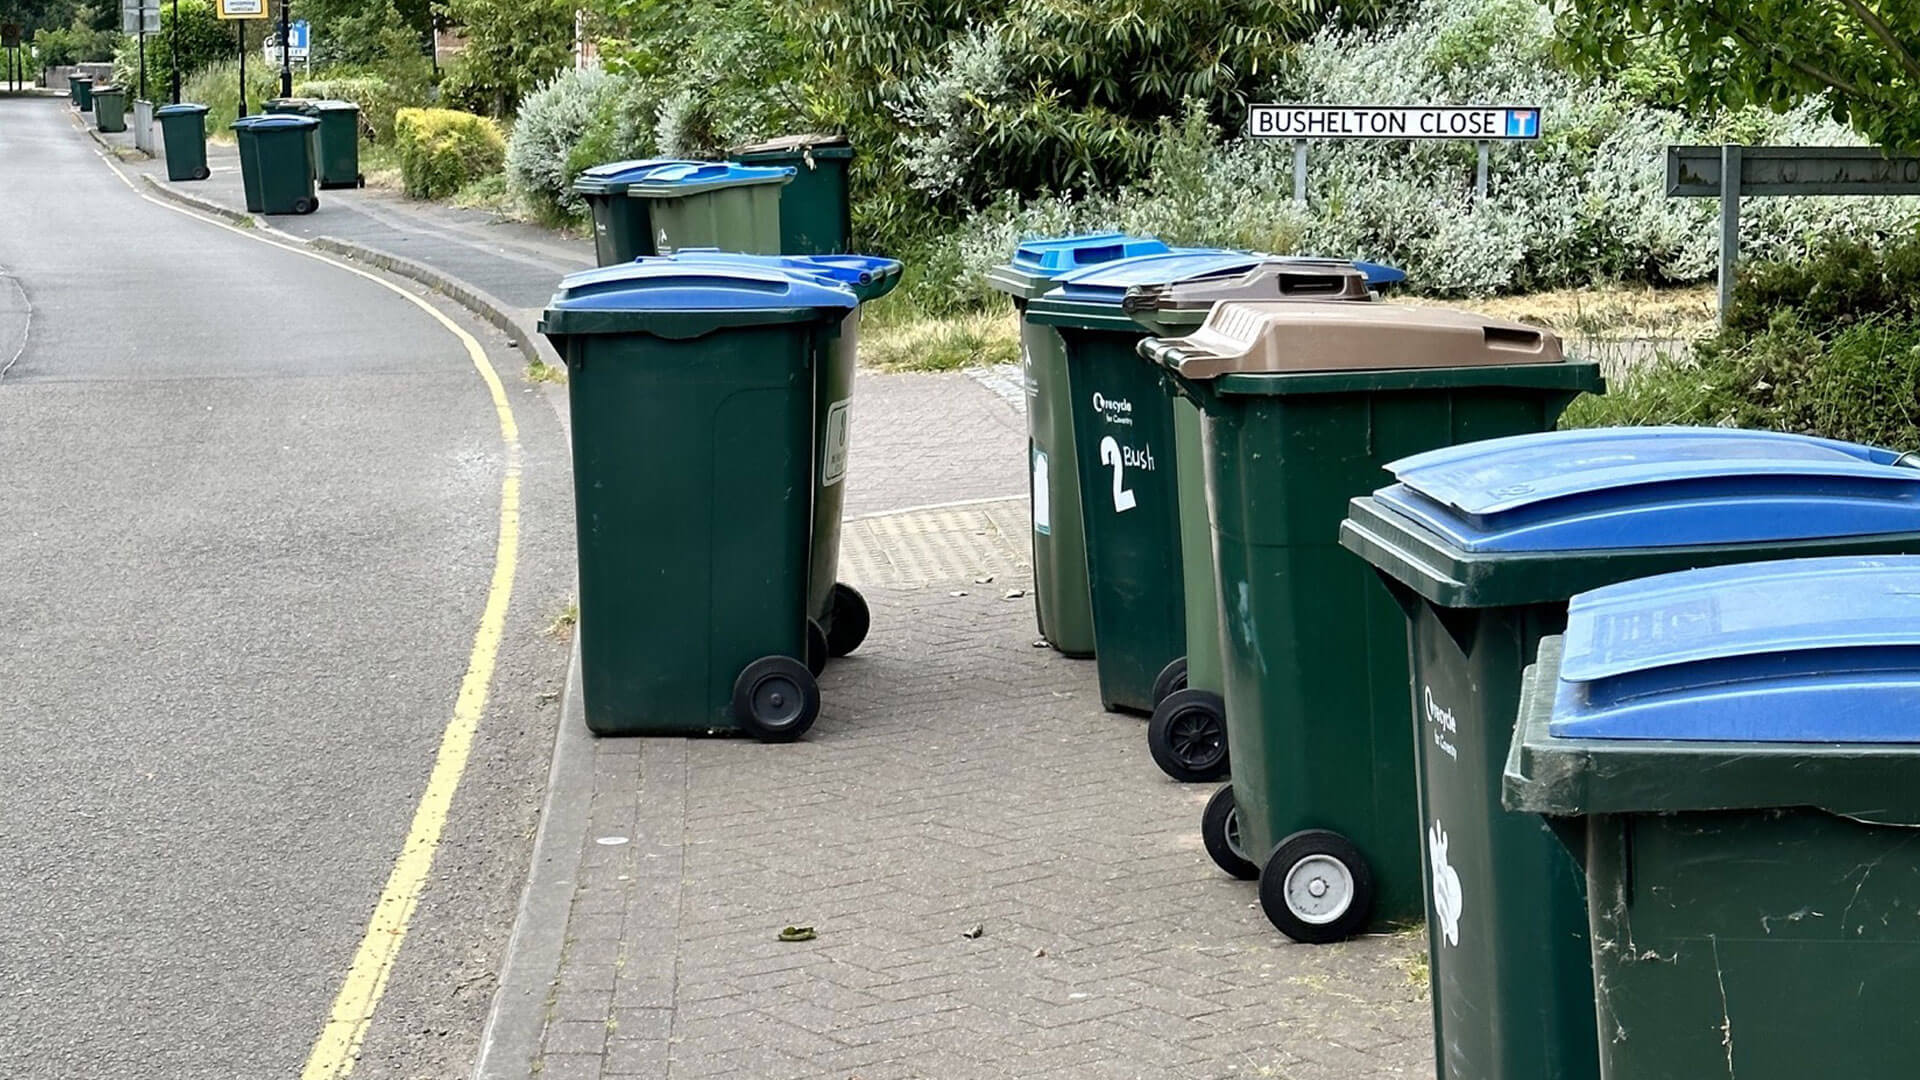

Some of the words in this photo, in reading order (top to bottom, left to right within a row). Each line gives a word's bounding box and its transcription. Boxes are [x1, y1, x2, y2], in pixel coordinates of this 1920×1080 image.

[1259, 111, 1407, 133] BUSHELTON
[1420, 112, 1497, 134] CLOSE
[1100, 435, 1137, 513] 2
